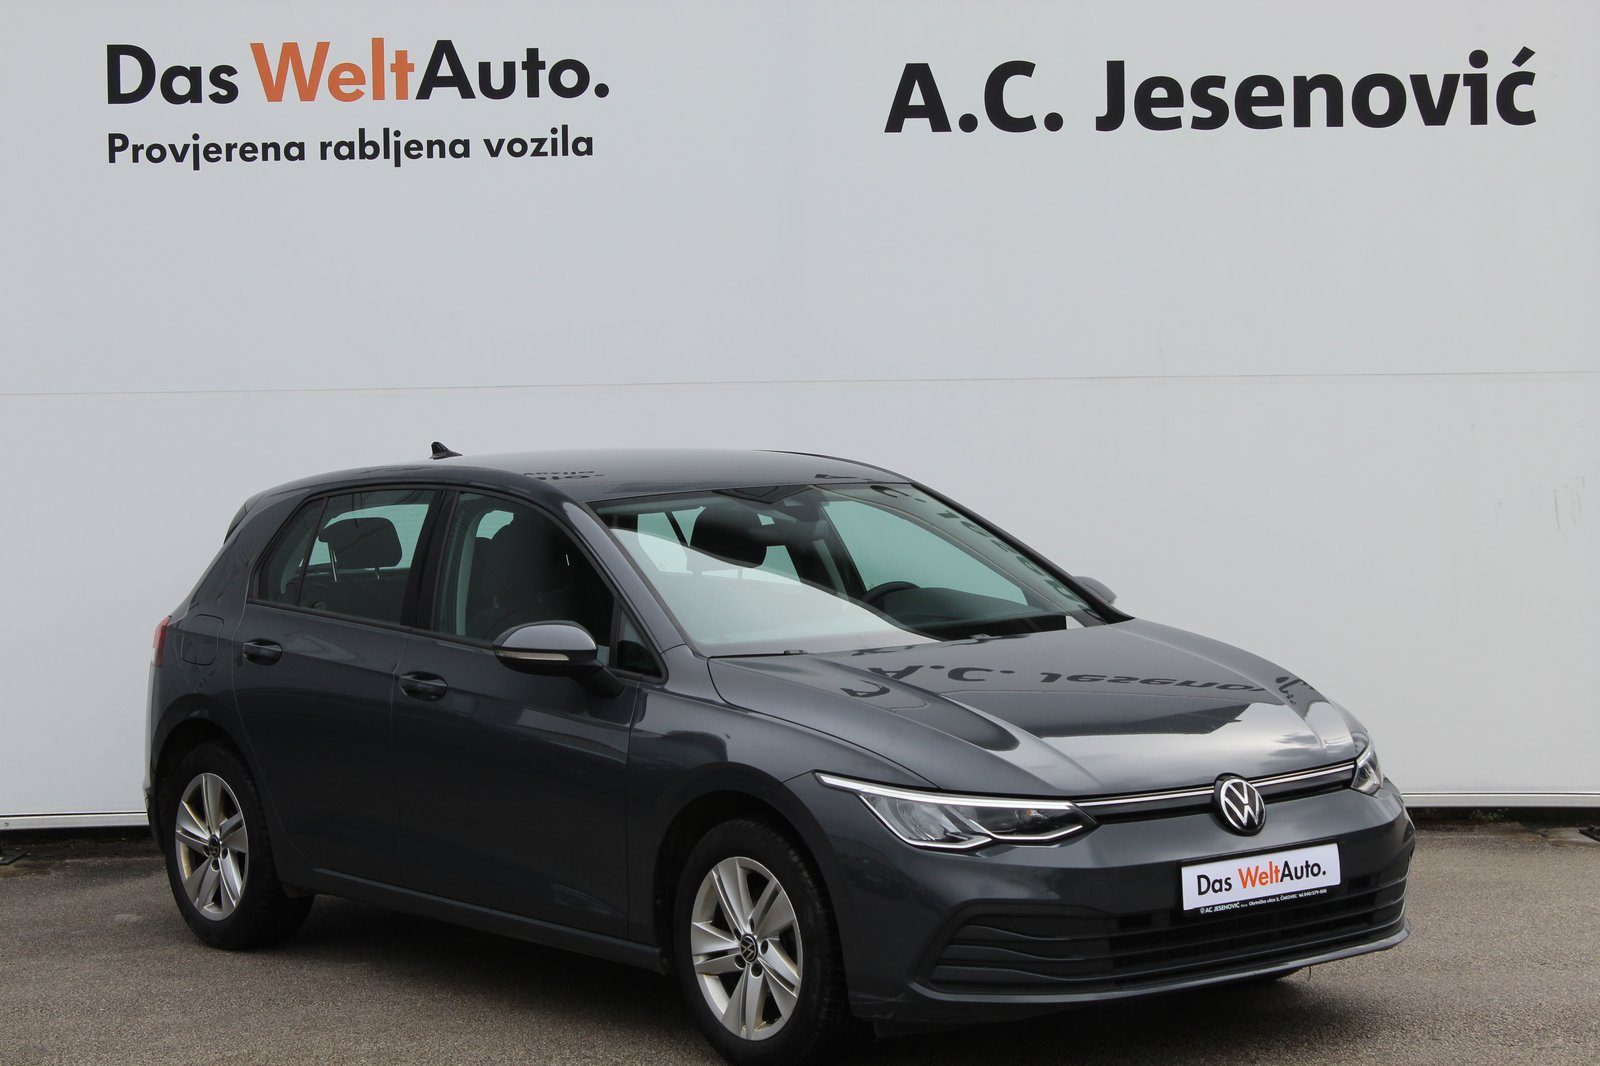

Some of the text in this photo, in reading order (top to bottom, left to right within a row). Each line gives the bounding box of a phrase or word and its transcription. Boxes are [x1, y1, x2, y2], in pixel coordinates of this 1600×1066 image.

[107, 37, 609, 105] Das WeltAuto.
[884, 45, 1537, 134] A.C. Jesenović
[107, 124, 594, 171] Provjerena rabljena vozila
[1197, 860, 1326, 896] Das WeltAuto.
[1214, 902, 1240, 912] JESENOVIĆ
